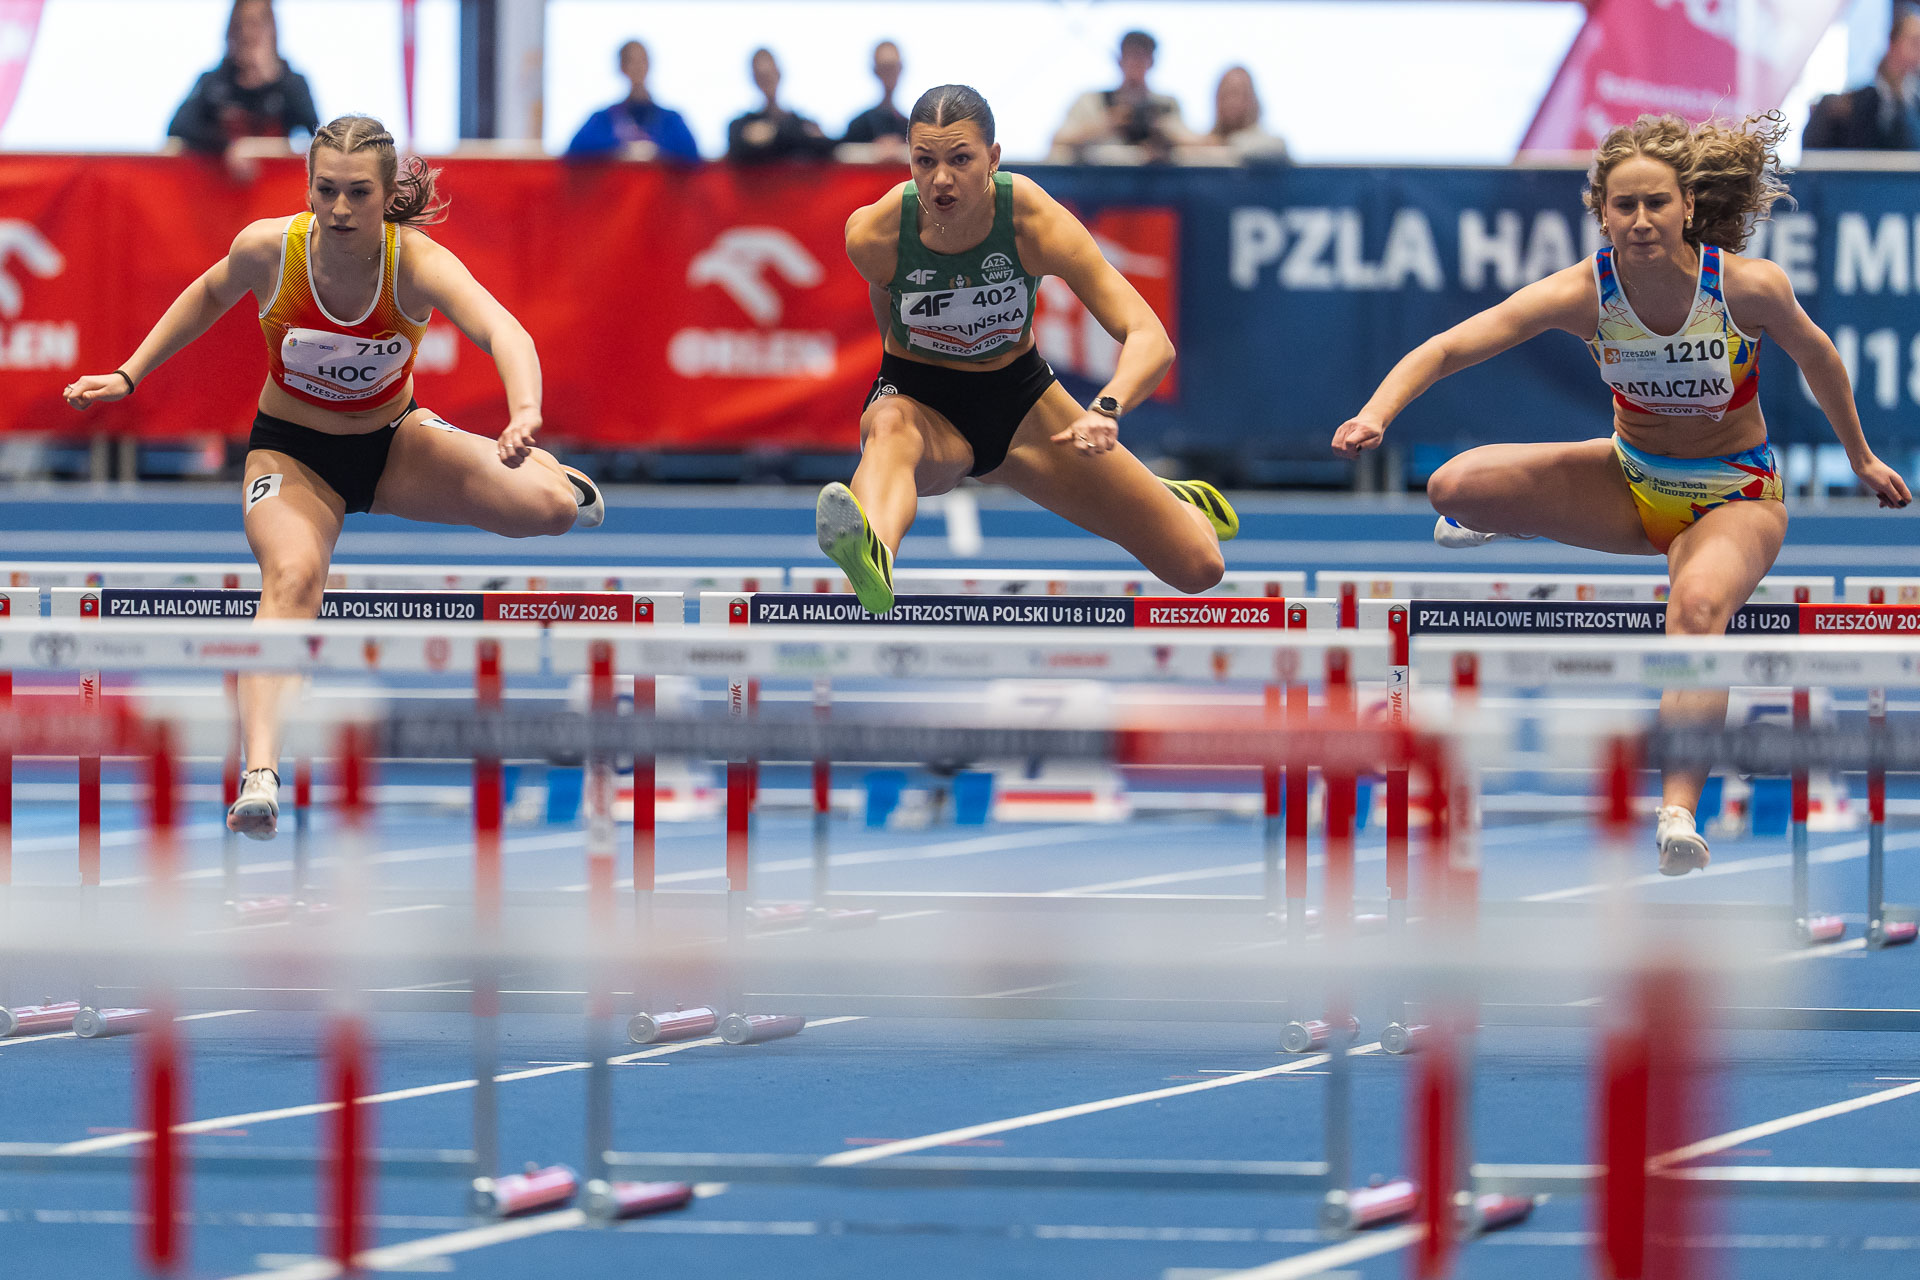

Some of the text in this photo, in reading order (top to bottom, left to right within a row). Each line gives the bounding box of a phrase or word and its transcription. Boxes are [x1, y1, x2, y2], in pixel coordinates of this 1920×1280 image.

[1230, 207, 1443, 292] PZLA
[906, 269, 937, 285] 4F
[988, 270, 1010, 280] AWF
[909, 285, 1017, 317] 4F 402
[356, 341, 402, 356] 710
[1621, 349, 1657, 358] rzeszów
[1663, 338, 1725, 363] 1210
[318, 365, 377, 382] HOC
[305, 383, 358, 400] RZESZÓW
[250, 475, 271, 503] 5
[1652, 484, 1708, 499] Junoszyn
[1653, 477, 1708, 489] Agro-Tech
[110, 599, 150, 615] PZLA
[154, 599, 221, 616] HALOWE
[342, 601, 398, 618] POLSKI
[402, 602, 432, 619] U18
[436, 602, 441, 619] i
[444, 603, 475, 619] U20
[499, 600, 618, 621] RZESZÓW 2026
[759, 604, 799, 620] PZLA
[803, 605, 871, 621] HALOWE
[993, 606, 1048, 622] POLSKI
[1052, 606, 1083, 623] U18
[1087, 606, 1091, 623] i
[1095, 607, 1126, 623] U20
[1150, 605, 1270, 624] RZESZÓW 2026
[1419, 610, 1459, 627] PZLA
[1464, 611, 1531, 627] HALOWE
[1536, 612, 1652, 628] MISTRZOSTWA
[1750, 613, 1755, 629] i
[1759, 614, 1791, 630] U20
[1815, 611, 1894, 630] RZESZÓW
